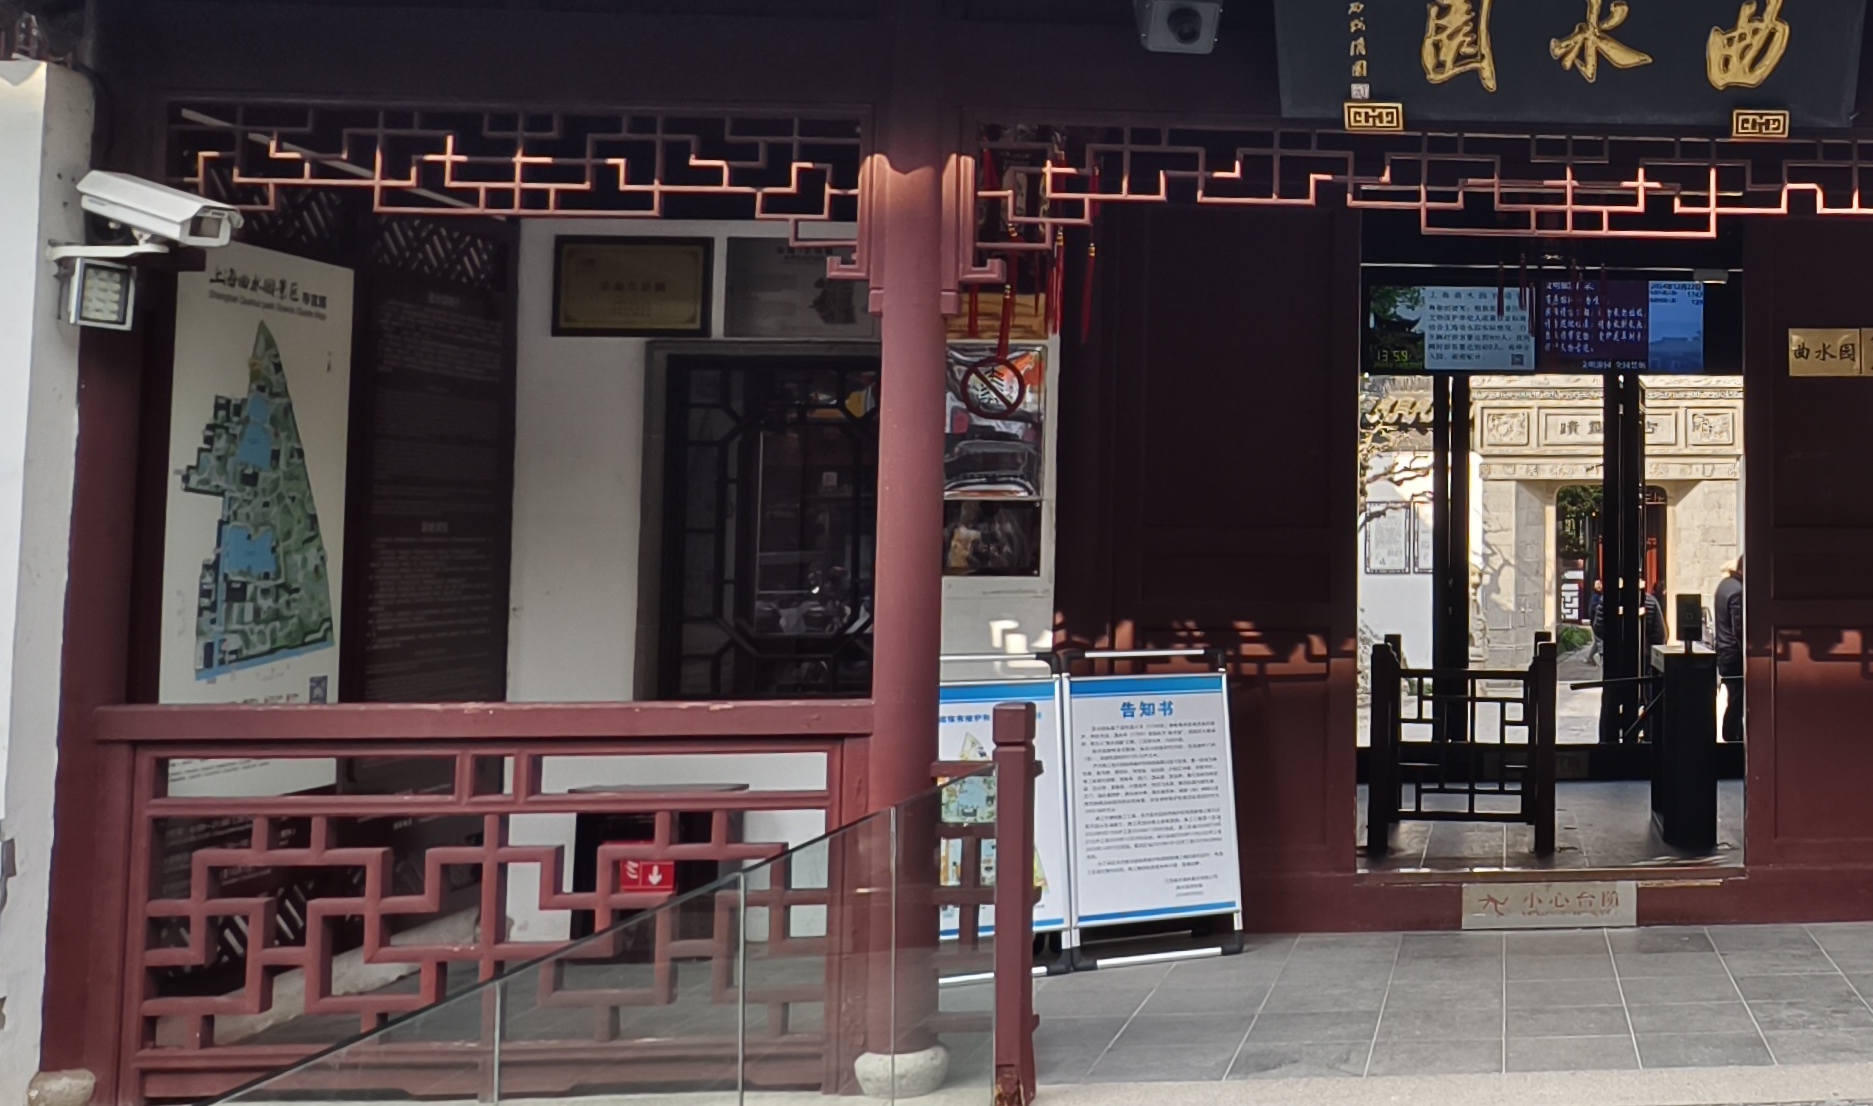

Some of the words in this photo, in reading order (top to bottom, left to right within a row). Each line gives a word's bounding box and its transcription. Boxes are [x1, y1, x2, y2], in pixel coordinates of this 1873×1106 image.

[1793, 342, 1856, 362] 曲水园
[1120, 701, 1173, 718] 告知书
[1523, 890, 1619, 908] 小心台阶
